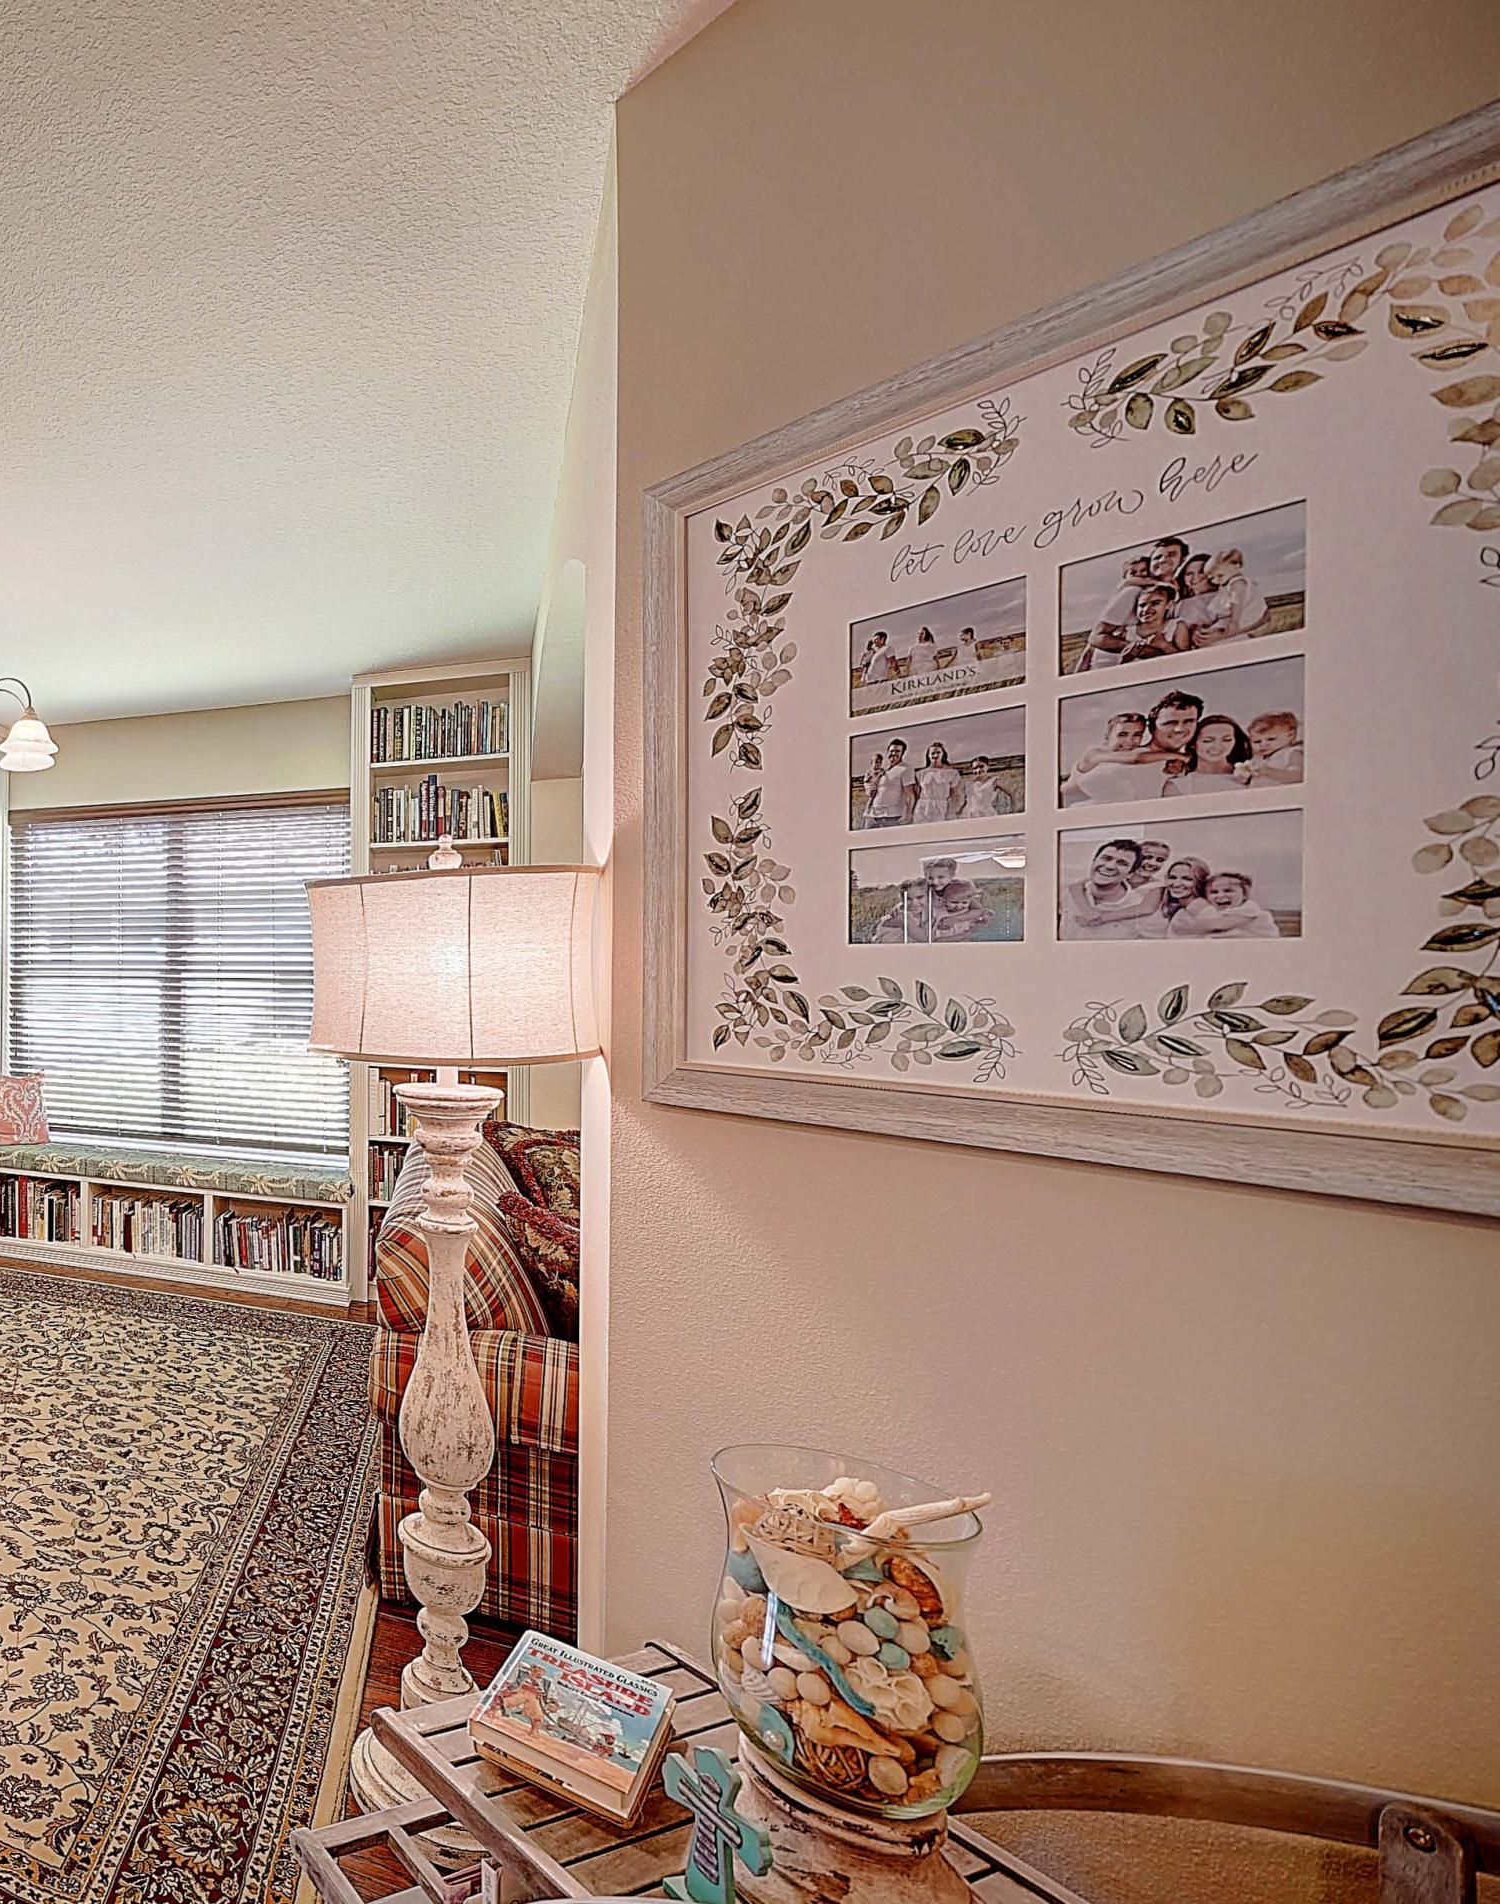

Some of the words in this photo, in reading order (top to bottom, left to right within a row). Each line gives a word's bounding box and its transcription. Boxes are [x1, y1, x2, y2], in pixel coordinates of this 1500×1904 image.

[890, 541, 945, 583] let
[953, 524, 1027, 564] love
[1034, 487, 1144, 549] grow
[1159, 451, 1259, 502] here
[891, 666, 976, 695] KIRKLAND'S
[528, 1646, 654, 1707] TREASURE
[531, 1637, 558, 1655] GREAT
[560, 1650, 615, 1679] ILLUSTRATED
[616, 1674, 658, 1697] CLASSICS
[560, 1672, 652, 1717] ISLAND
